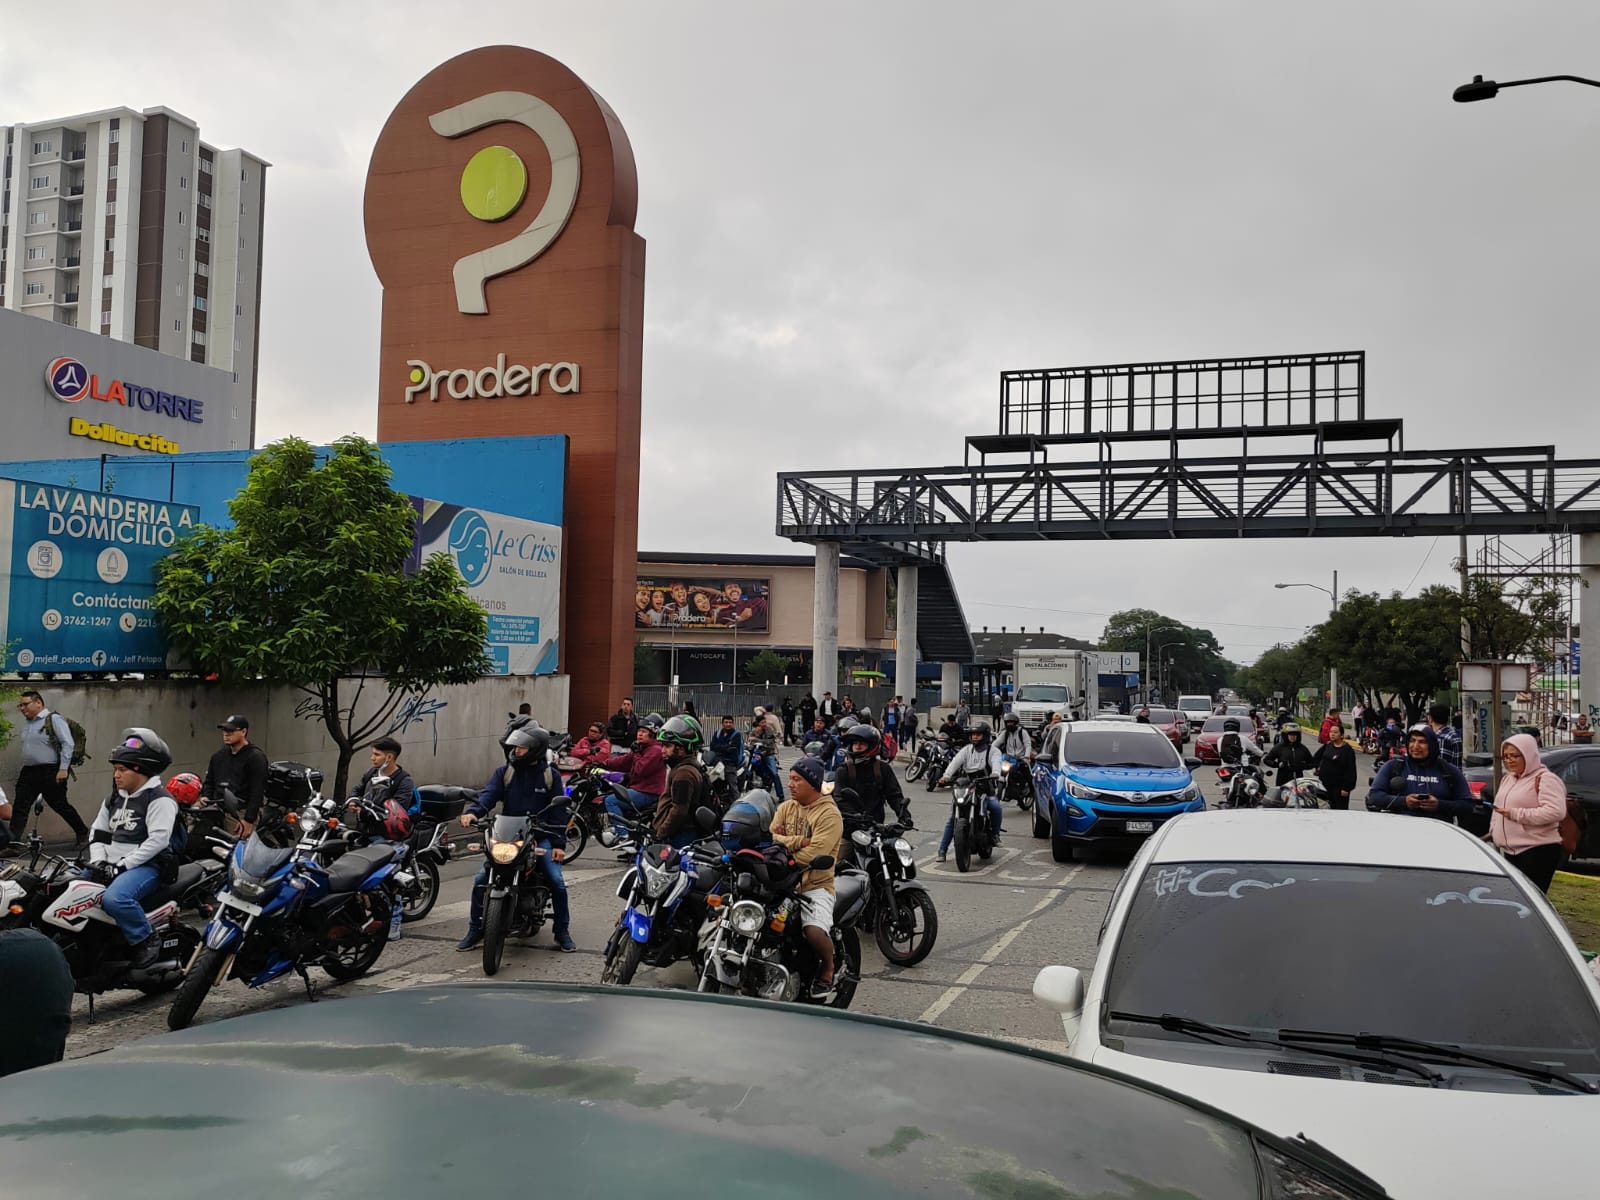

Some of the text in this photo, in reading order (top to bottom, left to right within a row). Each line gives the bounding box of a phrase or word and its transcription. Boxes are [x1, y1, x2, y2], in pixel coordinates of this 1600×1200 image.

[405, 352, 580, 403] Pradera
[70, 417, 180, 455] Dollarcity
[19, 484, 193, 529] LAVANDERIA A
[48, 513, 176, 548] DOMICILIO
[499, 565, 547, 578] SALÓN DE BELLEZA
[63, 615, 112, 627] 3762-1247
